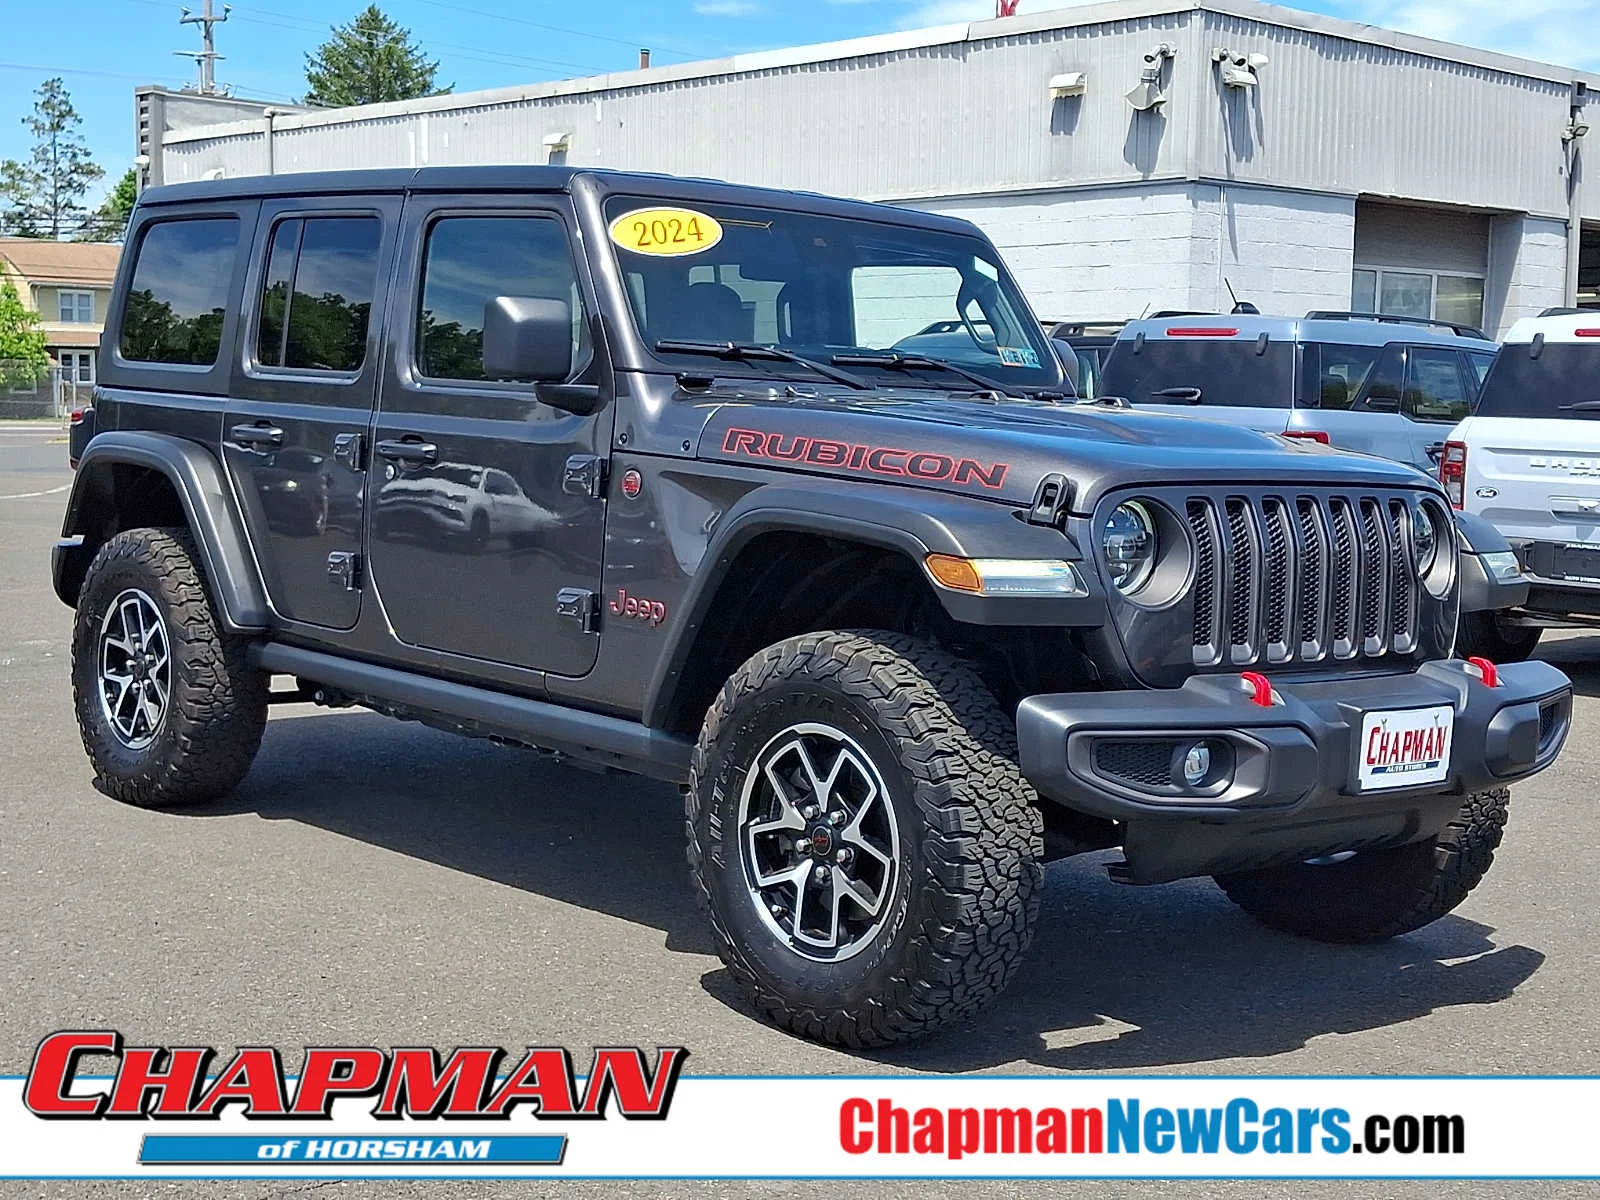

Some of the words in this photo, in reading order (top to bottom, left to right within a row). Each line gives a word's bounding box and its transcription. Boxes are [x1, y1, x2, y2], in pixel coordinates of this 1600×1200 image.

[633, 217, 704, 247] 2024
[722, 428, 1009, 489] RUBICON
[1529, 457, 1600, 470] BRO
[609, 588, 666, 628] Jeep
[1366, 726, 1448, 765] CHAPMAN
